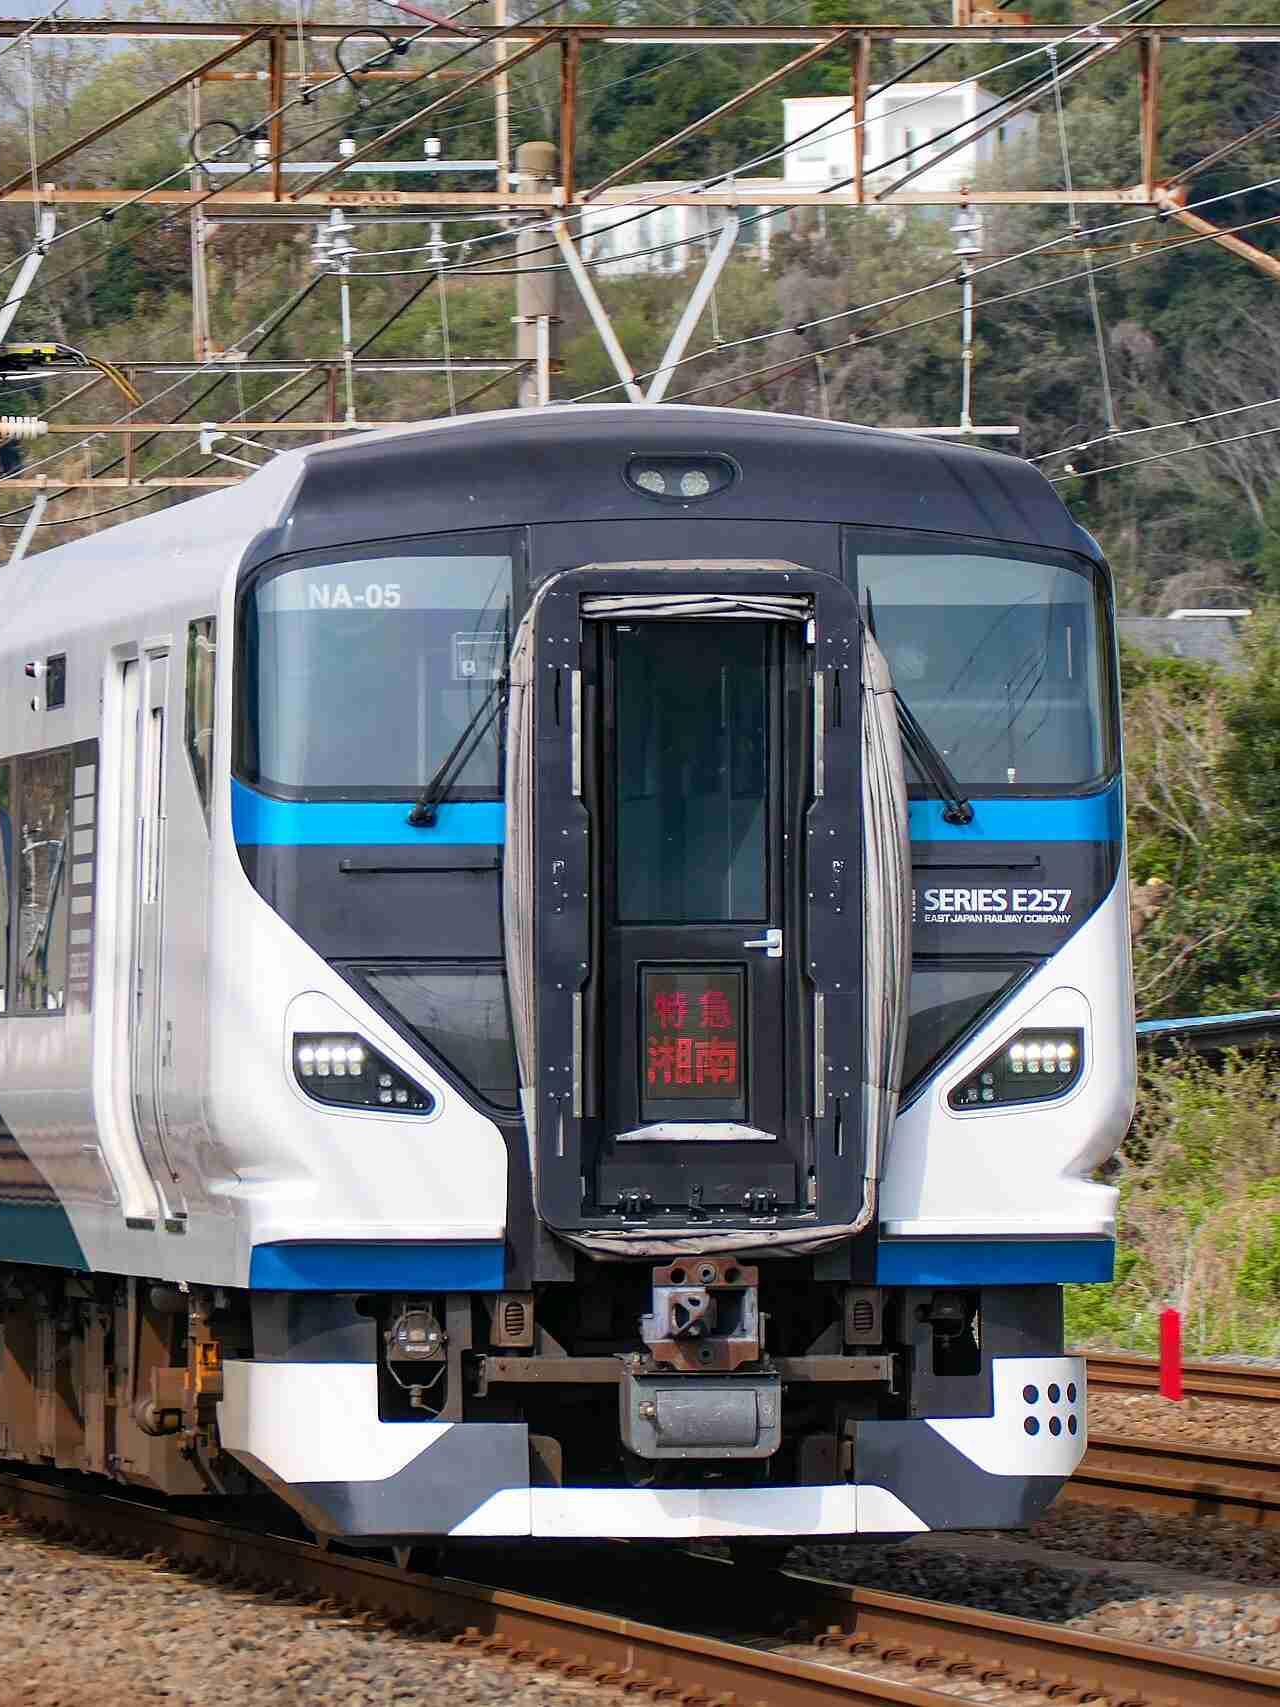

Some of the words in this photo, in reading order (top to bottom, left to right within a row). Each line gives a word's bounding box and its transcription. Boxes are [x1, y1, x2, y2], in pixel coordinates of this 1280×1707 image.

[308, 583, 401, 609] NA-05
[924, 889, 1007, 911] SERIES
[1012, 889, 1072, 911] E257
[925, 914, 950, 923] EAST
[951, 914, 982, 923] JAPAN
[984, 914, 1023, 923] RAILWAY
[1024, 914, 1071, 923] COMPANY
[648, 1036, 737, 1086] 湘南
